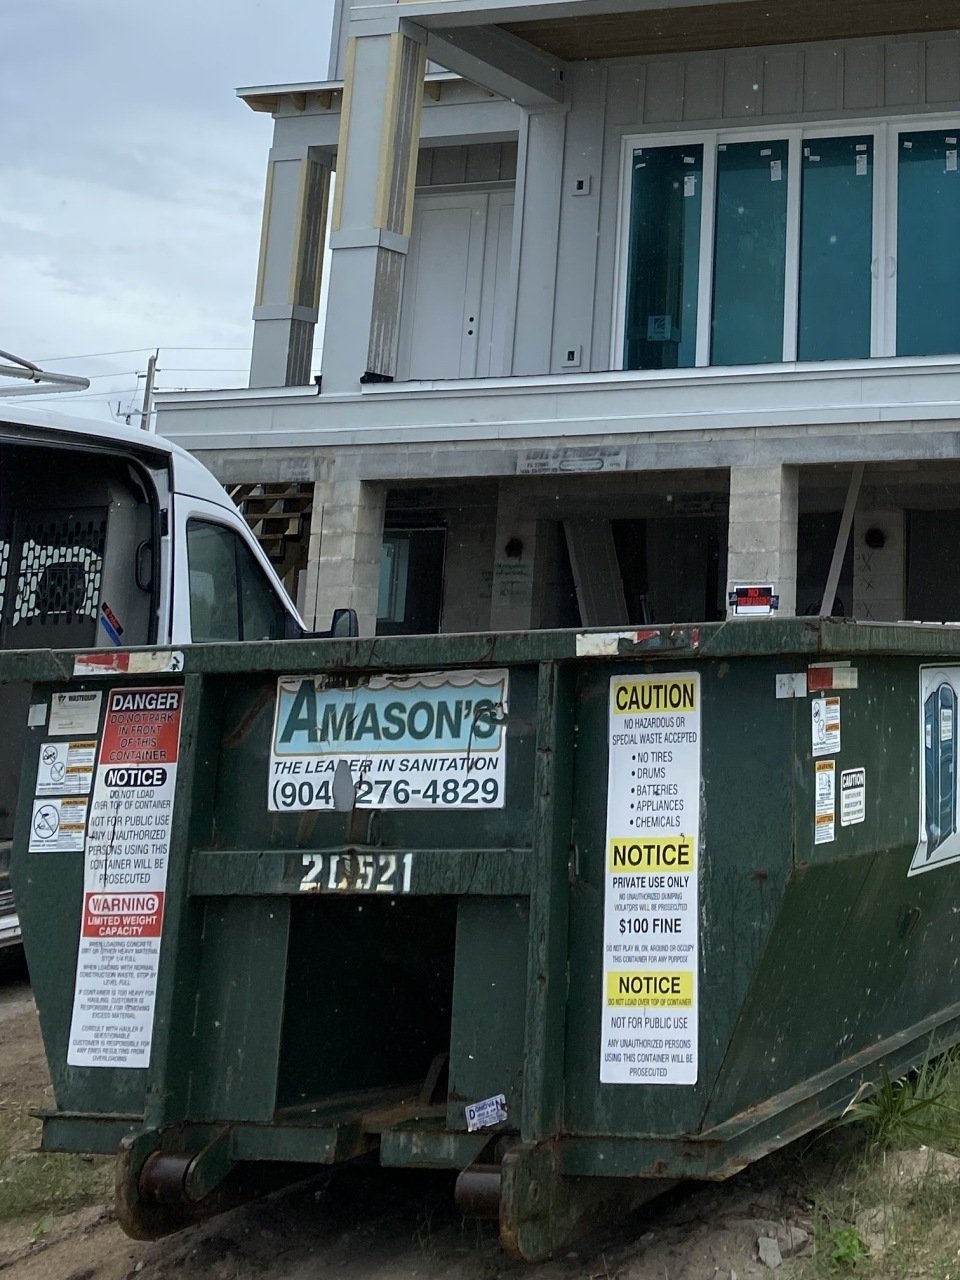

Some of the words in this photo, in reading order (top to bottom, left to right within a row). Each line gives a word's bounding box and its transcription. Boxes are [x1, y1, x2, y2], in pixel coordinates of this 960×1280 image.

[747, 588, 759, 597] NO
[111, 692, 179, 711] DANGER
[615, 682, 695, 711] CAUTION
[279, 678, 498, 744] AMASON'S
[110, 713, 125, 724] DO
[126, 713, 146, 724] NOT
[149, 712, 174, 722] PARK
[623, 718, 634, 730] NO
[634, 716, 675, 729] HAZARDOUS
[675, 716, 686, 728] OR
[119, 725, 128, 735] IN
[131, 725, 162, 735] FRONT
[120, 738, 134, 748] OF
[137, 737, 157, 747] THIS
[612, 734, 638, 746] SPECIAL
[640, 732, 663, 744] WASTE
[664, 731, 698, 743] ACCEPTED
[109, 750, 167, 761] CONTAINER
[637, 751, 649, 763] NO
[651, 750, 673, 763] TIRES
[274, 761, 302, 775] THE
[305, 759, 373, 774] LEAER
[377, 758, 395, 773] IN
[398, 756, 499, 773] SANITATION
[107, 768, 163, 786] NOTICE
[637, 767, 666, 779] DRUMS
[842, 772, 864, 789] CAUTION
[109, 790, 120, 799] DO
[121, 789, 135, 799] NOT
[136, 789, 155, 799] LOAD
[272, 779, 332, 810] (904
[355, 777, 500, 806] 276-4829
[636, 784, 678, 796] BATTERIES
[110, 800, 123, 810] TOP
[124, 800, 134, 810] OF
[134, 799, 171, 809] CONTAINER
[636, 799, 684, 812] APPLIANCES
[106, 816, 123, 827] FOR
[124, 815, 153, 826] PUBLIC
[154, 814, 170, 825] USE
[635, 815, 681, 828] CHEMICALS
[91, 830, 106, 841] ANY
[107, 829, 166, 841] UNAUTHORIZED
[88, 845, 122, 856] PERSONS
[124, 844, 149, 855] USING
[151, 844, 168, 854] THIS
[613, 844, 690, 867] NOTICE
[90, 859, 131, 870] CONTAINER
[133, 858, 152, 869] WILL
[154, 858, 164, 869] BE
[99, 873, 151, 884] PROSECUTED
[612, 876, 646, 889] PRIVATE
[648, 876, 666, 888] USE
[667, 876, 689, 888] ONLY
[92, 896, 156, 912] WARNING
[87, 915, 120, 926] LIMITED
[122, 915, 158, 925] WEIGHT
[619, 918, 649, 935] $100
[652, 918, 682, 934] FINE
[98, 926, 144, 936] CAPACITY
[618, 976, 681, 994] NOTICE
[611, 1016, 626, 1029] NOT
[627, 1016, 643, 1029] FOR
[645, 1016, 672, 1029] PUBLIC
[673, 1016, 688, 1029] USE
